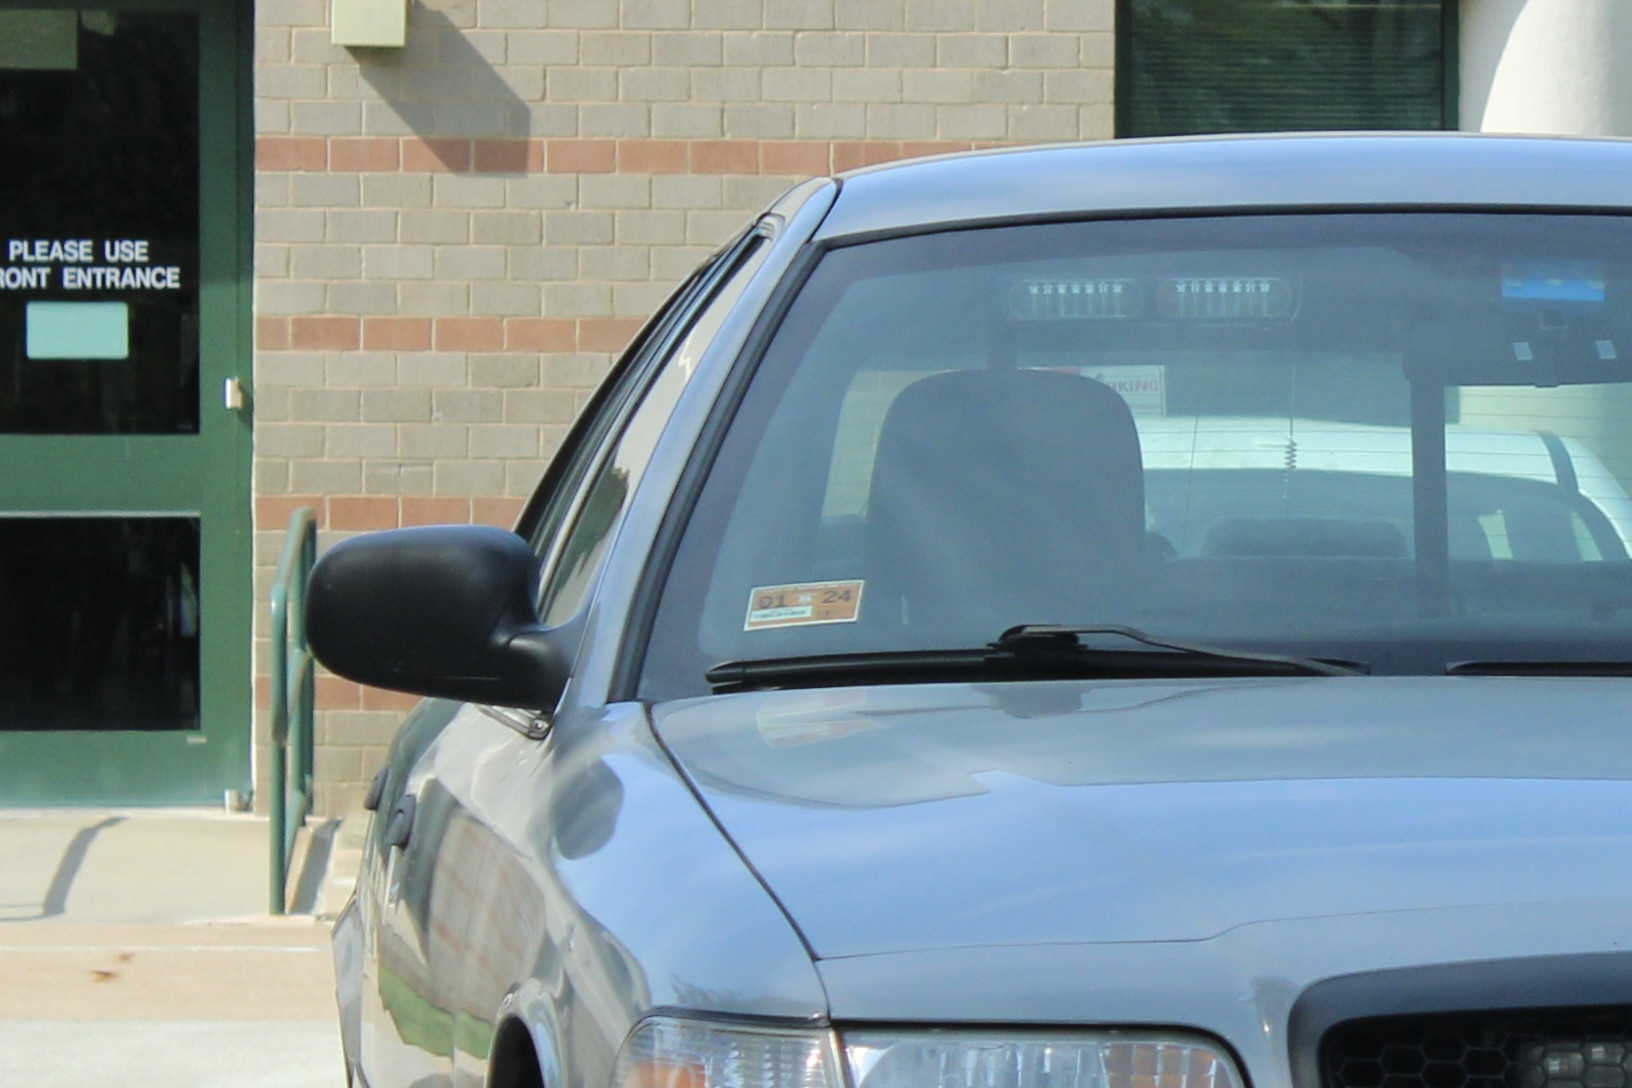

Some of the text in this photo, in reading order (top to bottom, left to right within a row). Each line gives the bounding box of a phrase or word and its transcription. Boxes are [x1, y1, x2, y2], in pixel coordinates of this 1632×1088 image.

[9, 240, 149, 262] PLEASE USE
[63, 267, 181, 289] ENTRANCE
[758, 589, 852, 610] 01 24
